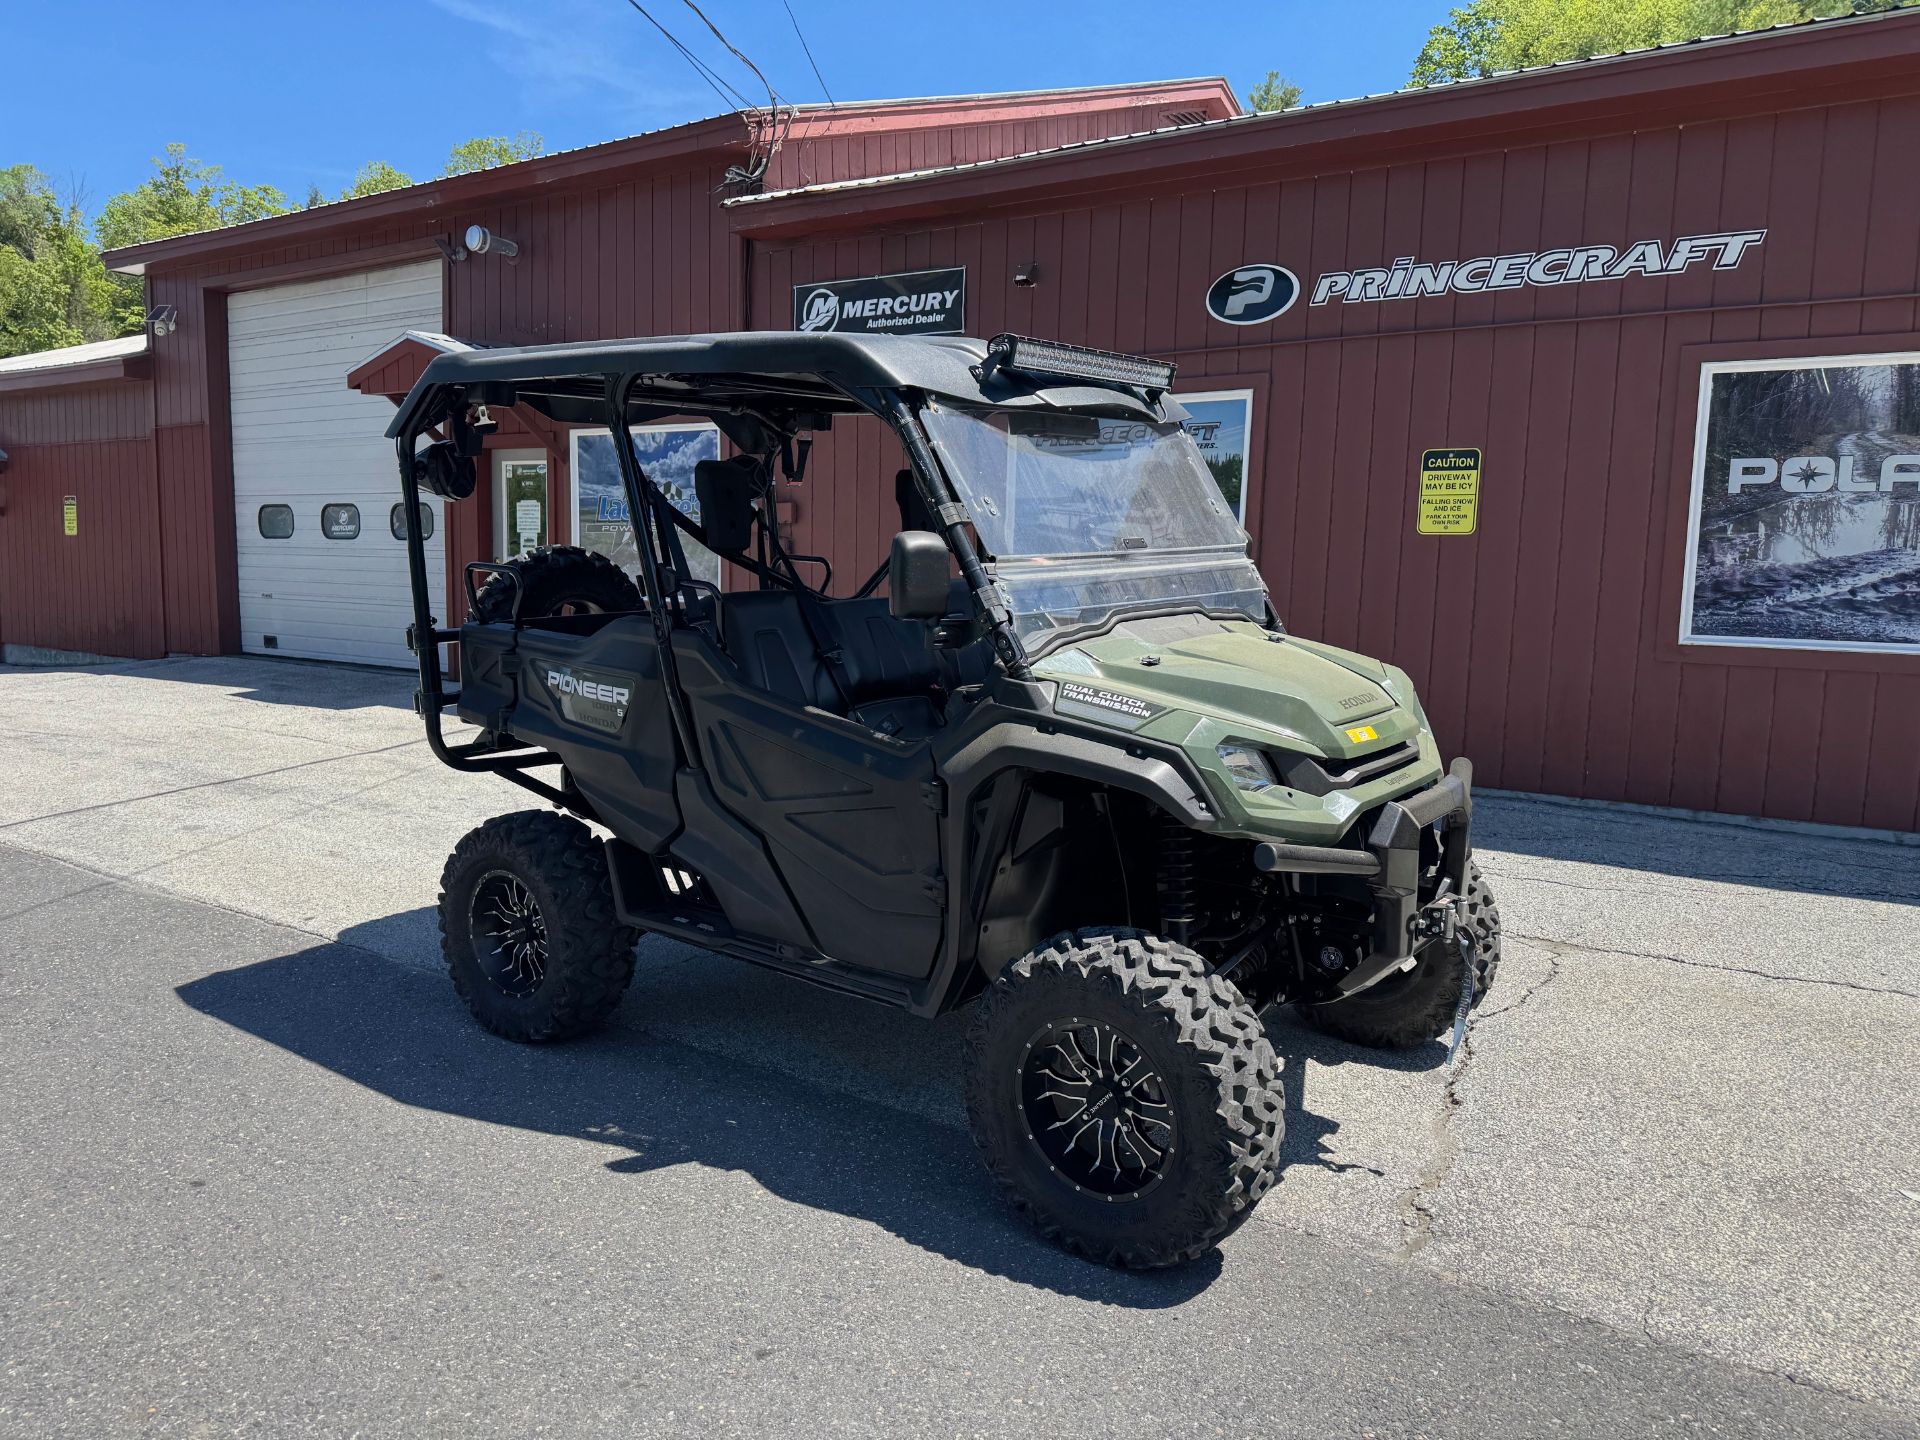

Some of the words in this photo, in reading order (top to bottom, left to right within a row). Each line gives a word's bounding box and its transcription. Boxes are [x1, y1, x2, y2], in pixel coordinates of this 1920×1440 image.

[1310, 229, 1768, 306] PRINCECRAFT
[842, 289, 960, 319] MERCURY
[866, 314, 914, 329] Authorized
[915, 312, 946, 324] Dealer
[1428, 458, 1475, 468] CAUTION
[1427, 473, 1472, 481] DRIVEWAY
[547, 670, 629, 706] PIONEER
[1064, 683, 1095, 696] DUAL
[1099, 691, 1146, 708] CLUTCH
[1338, 693, 1379, 710] HONDA
[1062, 689, 1152, 718] TRANSMISSION
[1457, 990, 1471, 1020] WINCH
